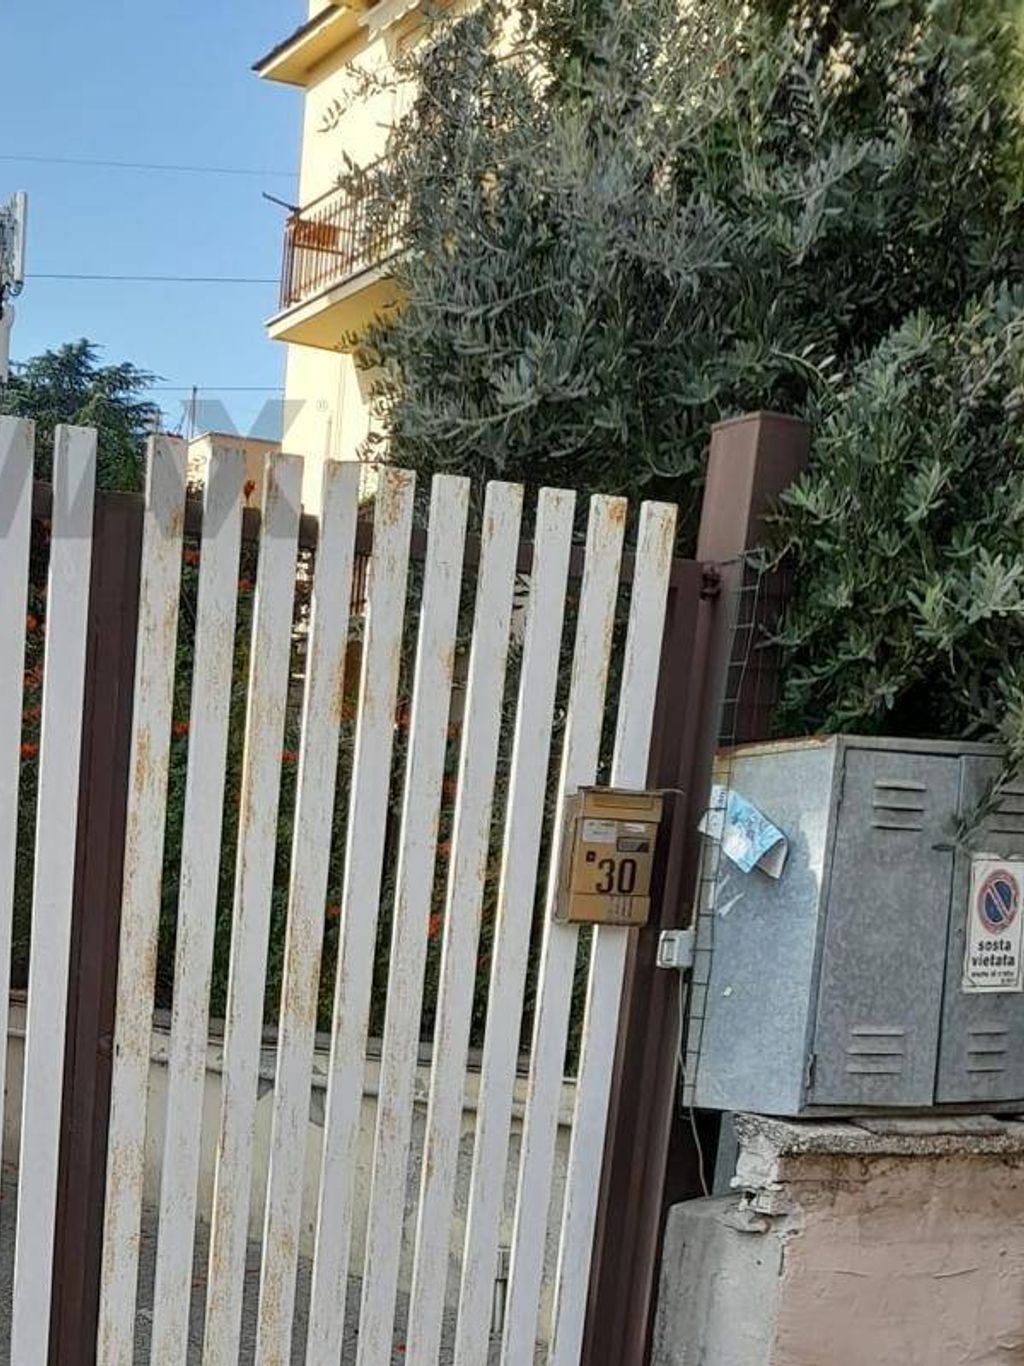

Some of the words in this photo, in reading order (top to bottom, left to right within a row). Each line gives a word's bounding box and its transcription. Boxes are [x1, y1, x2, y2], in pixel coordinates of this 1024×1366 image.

[595, 857, 638, 894] 30
[978, 938, 1012, 951] sosta
[972, 953, 1015, 967] vietata
